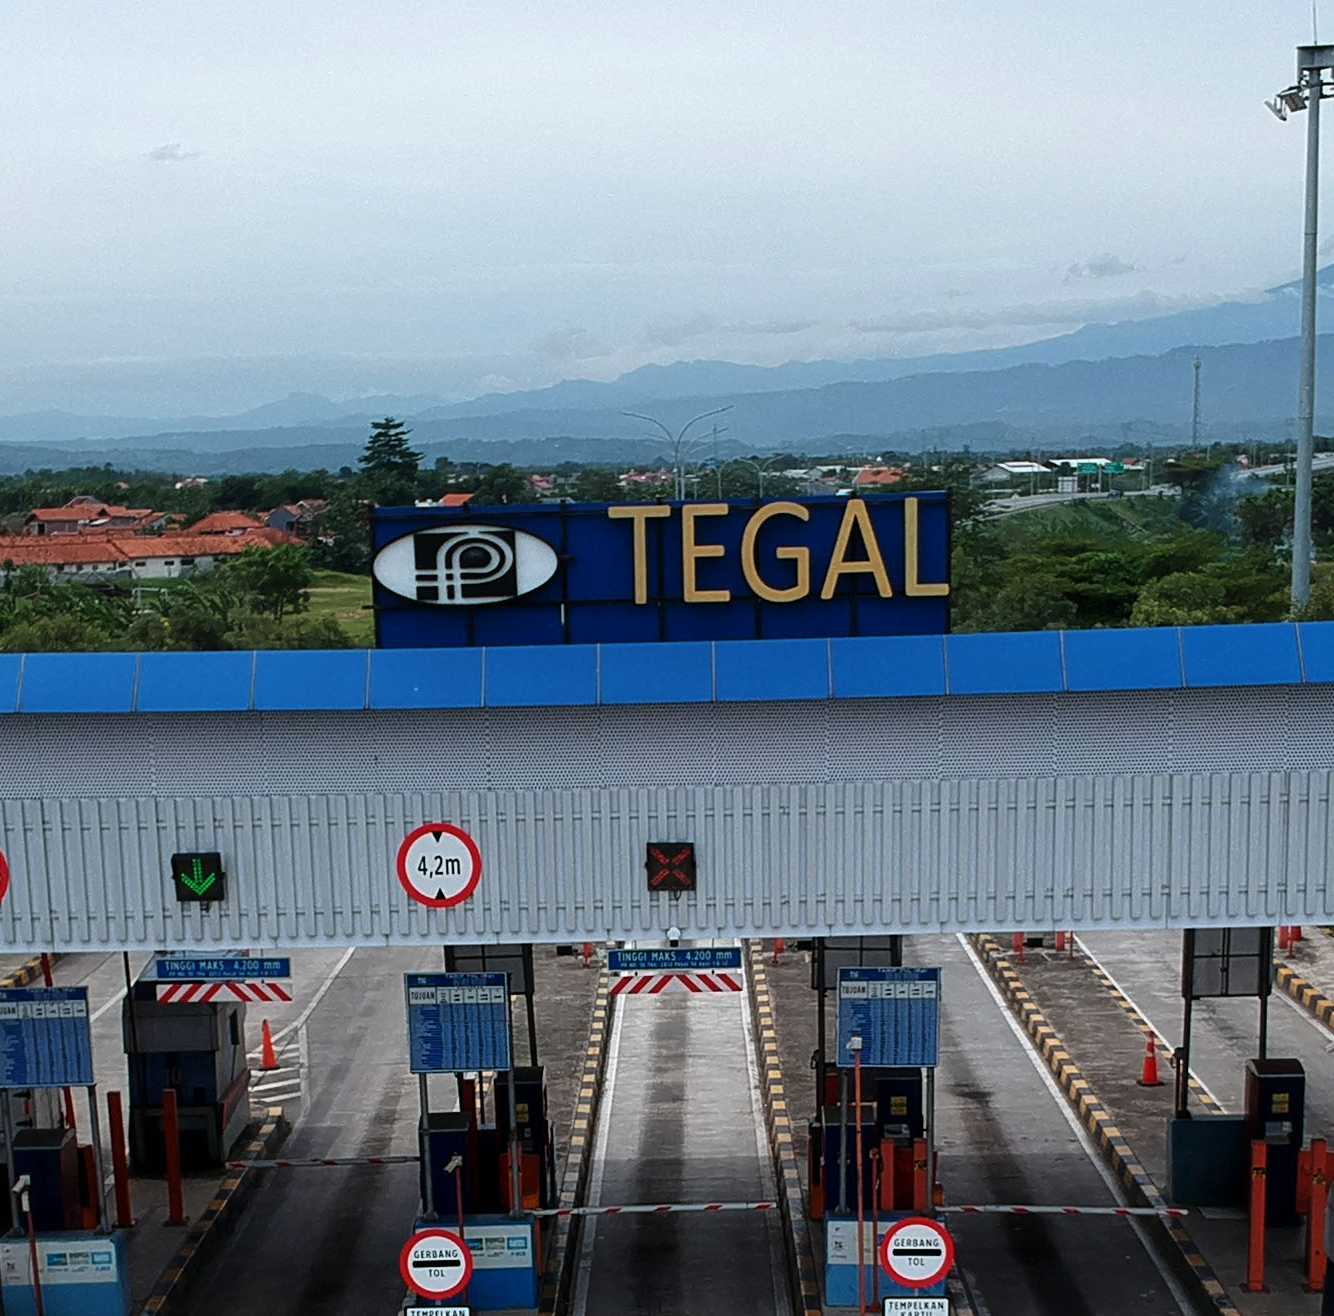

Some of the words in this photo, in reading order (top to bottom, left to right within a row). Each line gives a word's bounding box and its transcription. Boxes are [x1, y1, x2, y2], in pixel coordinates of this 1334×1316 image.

[607, 497, 950, 605] TEGAL
[418, 855, 461, 879] 4,2m
[617, 951, 647, 962] TINGGI
[685, 950, 711, 961] 4.200
[716, 951, 733, 960] mm
[165, 961, 195, 971] TINGGI
[233, 960, 259, 970] 4.200
[263, 961, 281, 969] mm
[411, 991, 435, 1000] TUJUAN
[894, 1238, 939, 1247] GERBANG
[414, 1250, 458, 1259] GERBANG
[907, 1257, 925, 1266] TOL
[428, 1269, 445, 1278] TOL
[889, 1301, 944, 1311] TEMPELKAN
